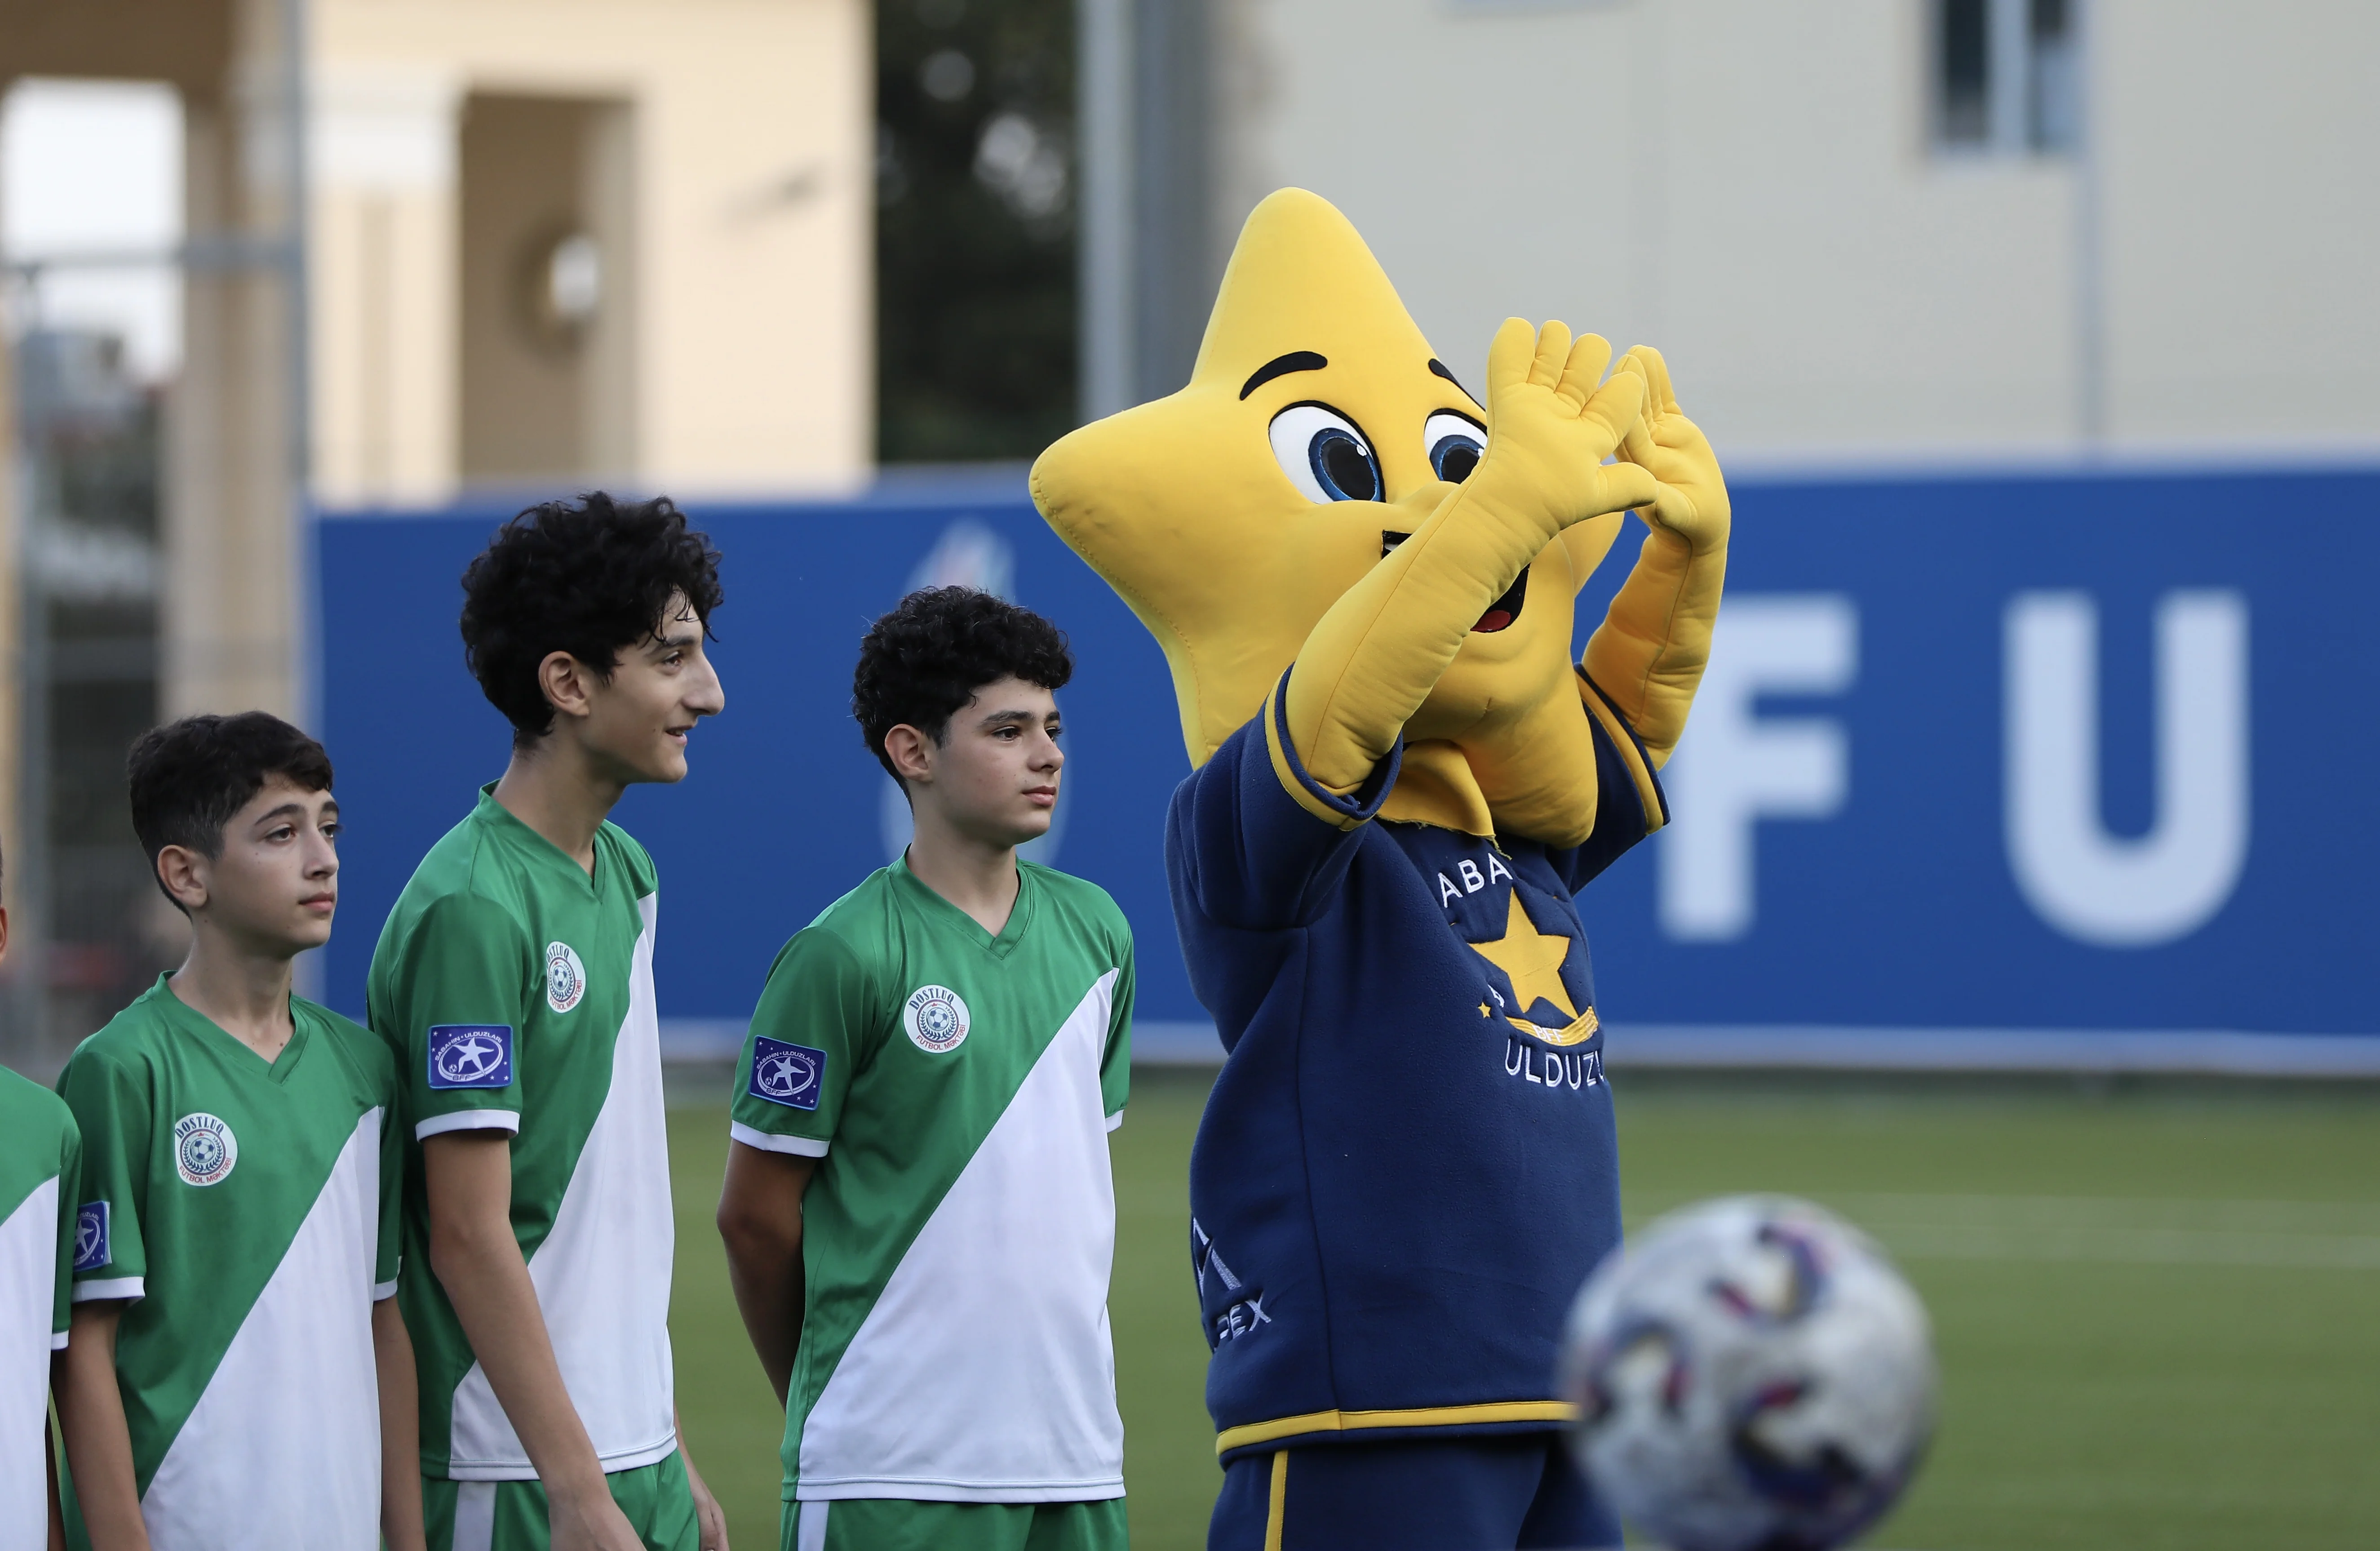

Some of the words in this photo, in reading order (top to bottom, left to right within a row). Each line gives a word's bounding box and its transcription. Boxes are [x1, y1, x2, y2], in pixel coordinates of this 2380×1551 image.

[549, 995, 567, 1010] FUTBOL
[908, 988, 954, 1010] DOSTLUQ
[916, 1035, 944, 1050] FUTBOL
[1531, 1024, 1564, 1044] BFF
[435, 1036, 461, 1061] SABAHIN
[464, 1031, 502, 1043] ULDUZLARI
[756, 1052, 779, 1070] SABAHIN
[783, 1051, 816, 1066] ULDUZLARI
[175, 1116, 224, 1139] DOSTLUQ
[179, 1165, 205, 1183] FUTBOL
